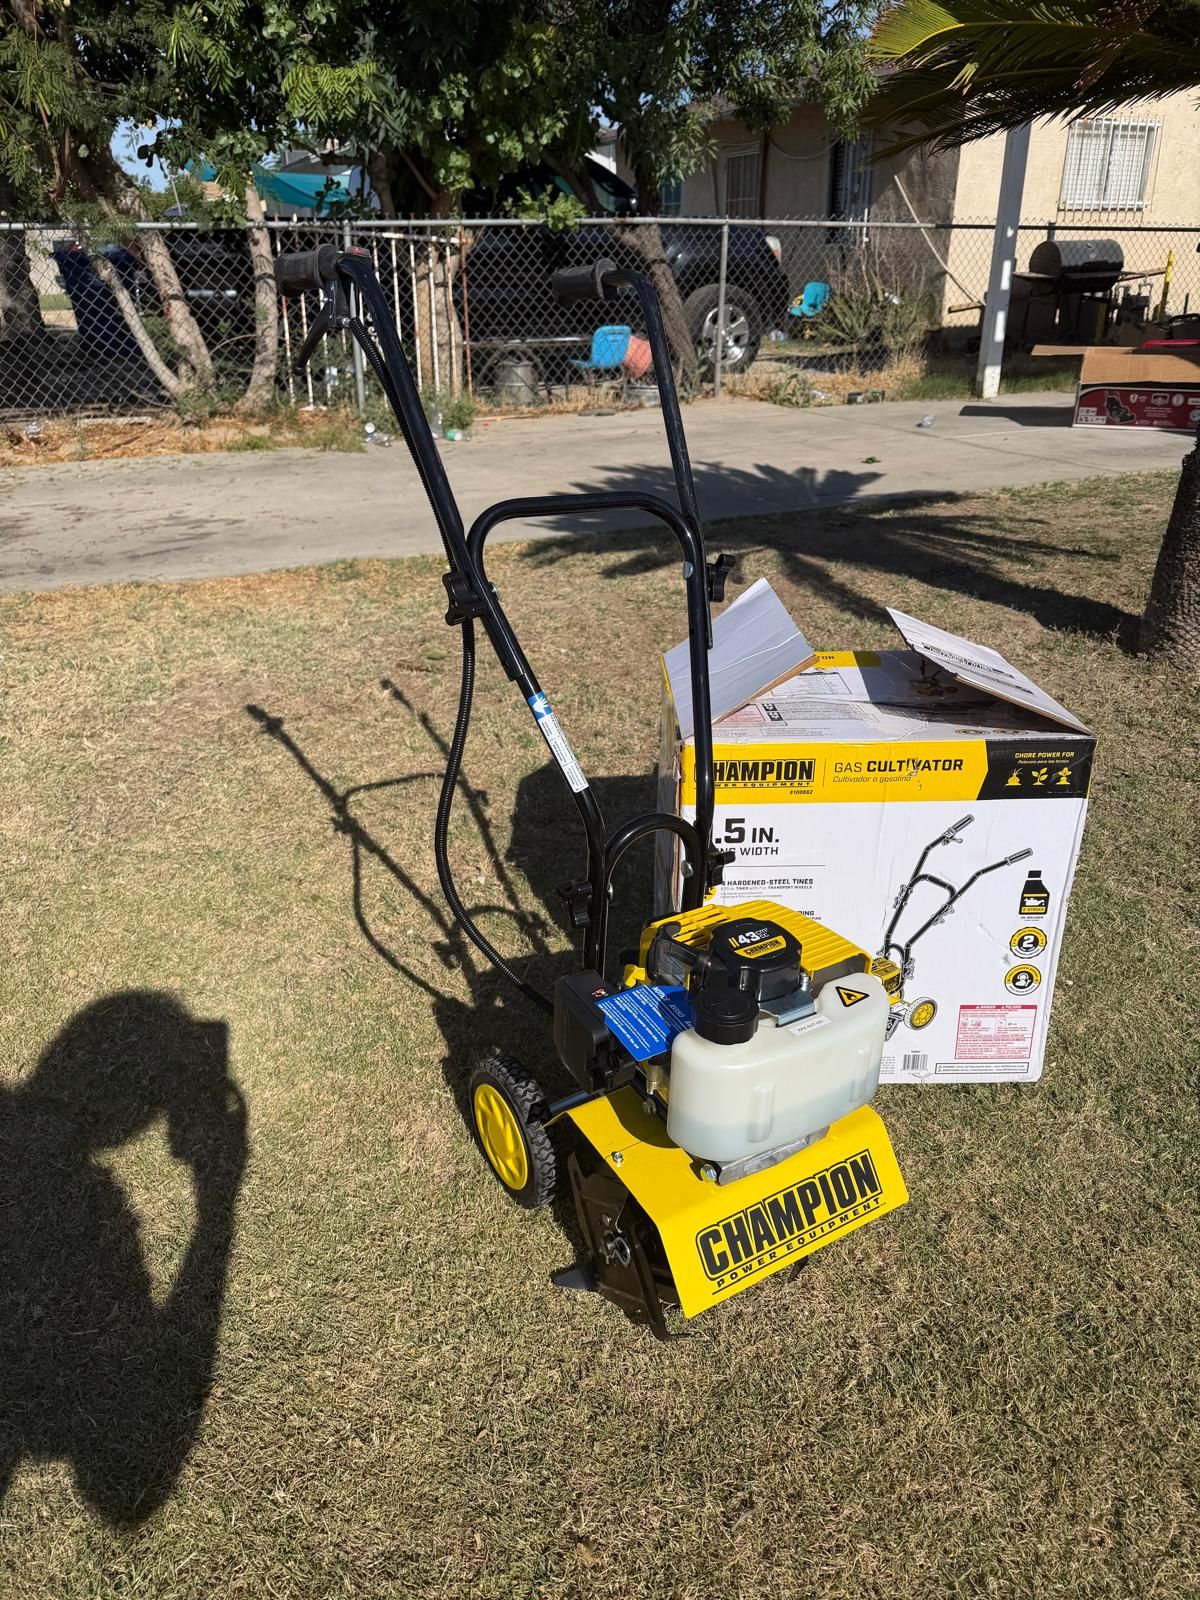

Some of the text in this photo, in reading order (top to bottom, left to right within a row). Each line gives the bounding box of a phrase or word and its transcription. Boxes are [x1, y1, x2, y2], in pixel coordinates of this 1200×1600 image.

[713, 759, 964, 782] HAMPION GAS CULTIVATOR
[832, 775, 870, 783] Cultivador
[879, 774, 912, 784] gasolina
[715, 818, 780, 844] .5 IN.
[739, 847, 779, 856] WIDTH
[738, 931, 760, 944] 43
[1022, 935, 1035, 948] 2
[744, 940, 782, 955] CHAMPION
[699, 1152, 880, 1278] CHAMPION
[717, 1197, 882, 1288] POWER EQUIPMENT
